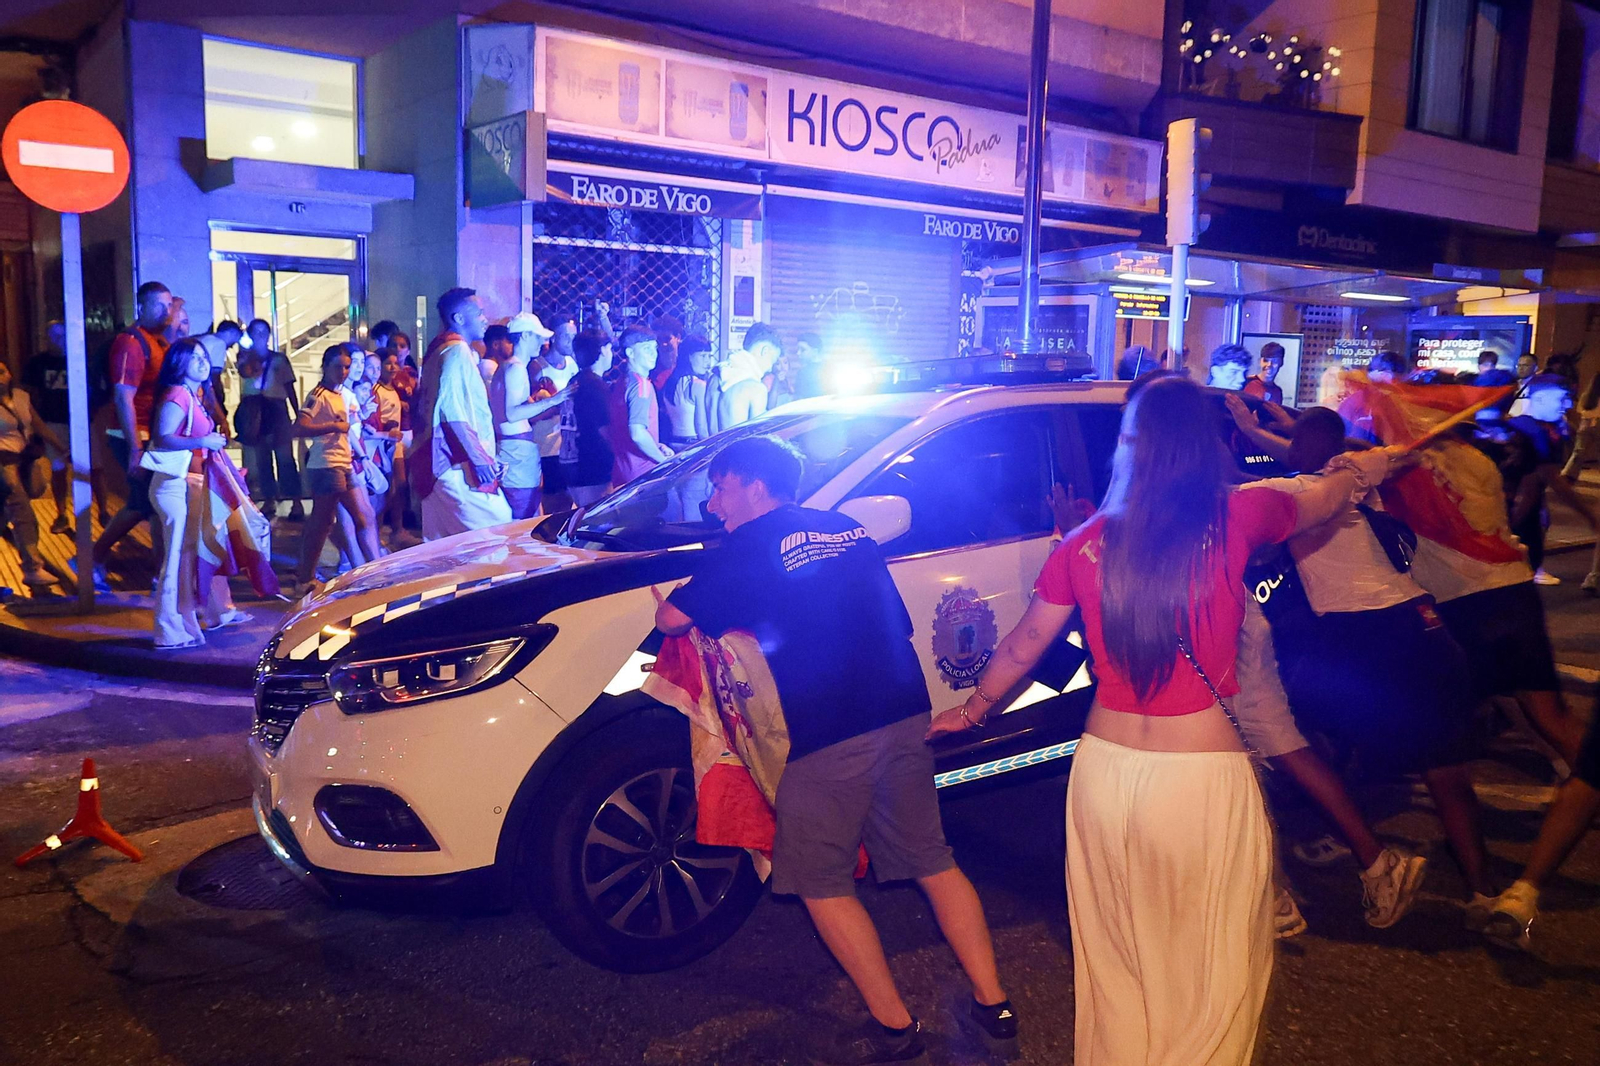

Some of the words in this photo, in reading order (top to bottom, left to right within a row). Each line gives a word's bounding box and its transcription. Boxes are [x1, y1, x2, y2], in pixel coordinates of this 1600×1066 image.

[788, 89, 963, 166] KIOSCO
[930, 128, 1002, 174] Padua
[571, 176, 628, 206] FARO
[630, 187, 659, 209] DE
[660, 186, 712, 214] VIGO
[923, 214, 961, 238] FARO
[963, 223, 983, 240] DE
[984, 221, 1019, 243] VIGO
[1419, 338, 1440, 348] Para
[1441, 339, 1485, 350] proteger
[1418, 347, 1431, 357] mi
[1417, 359, 1430, 368] en
[782, 547, 803, 562] ALWAYS
[784, 552, 808, 567] CRAFTED
[786, 557, 810, 573] VETERAN
